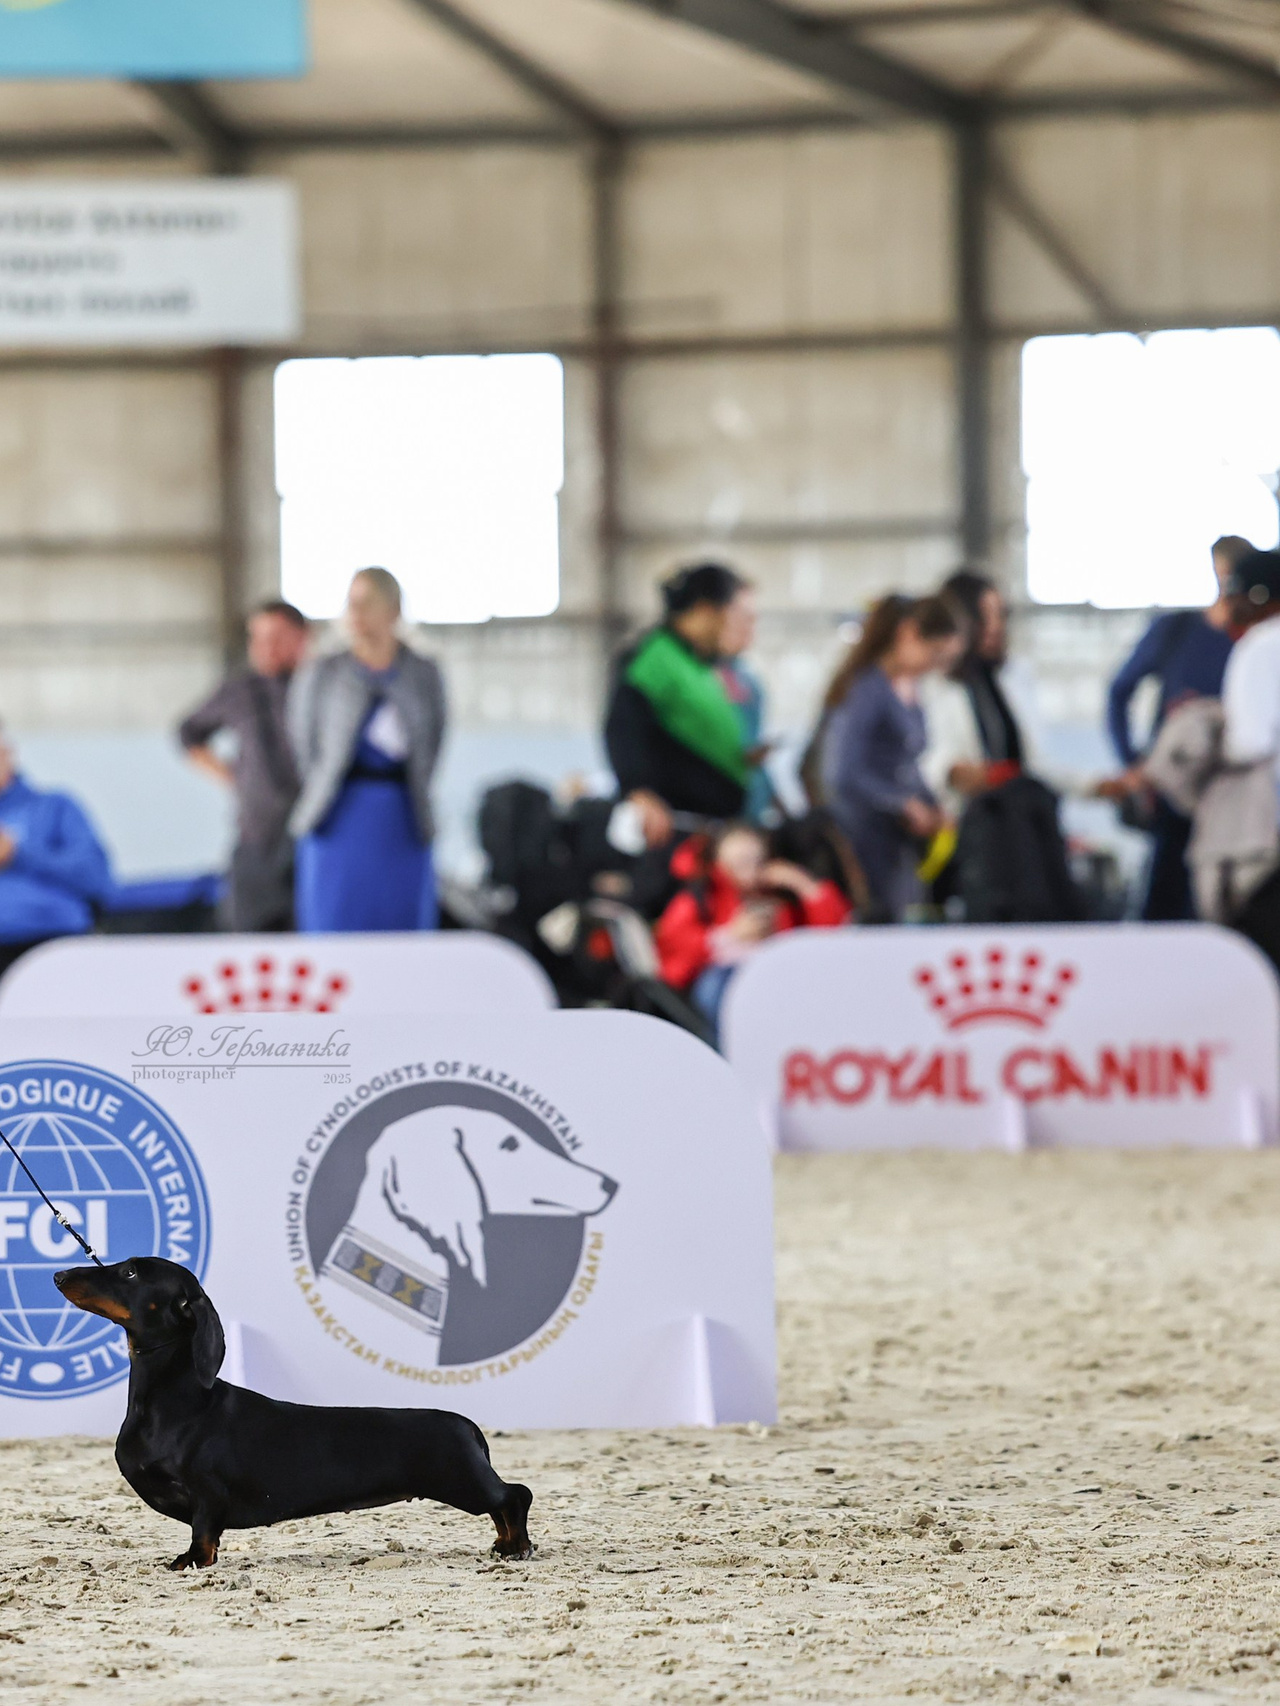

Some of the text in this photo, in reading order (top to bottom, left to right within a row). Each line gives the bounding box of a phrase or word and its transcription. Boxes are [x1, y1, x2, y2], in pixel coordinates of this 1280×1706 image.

[783, 1043, 1211, 1105] ROYAL CANIN
[286, 1061, 583, 1262] UNION OF CYNOLOGISTS OF KAZAKHSTAN
